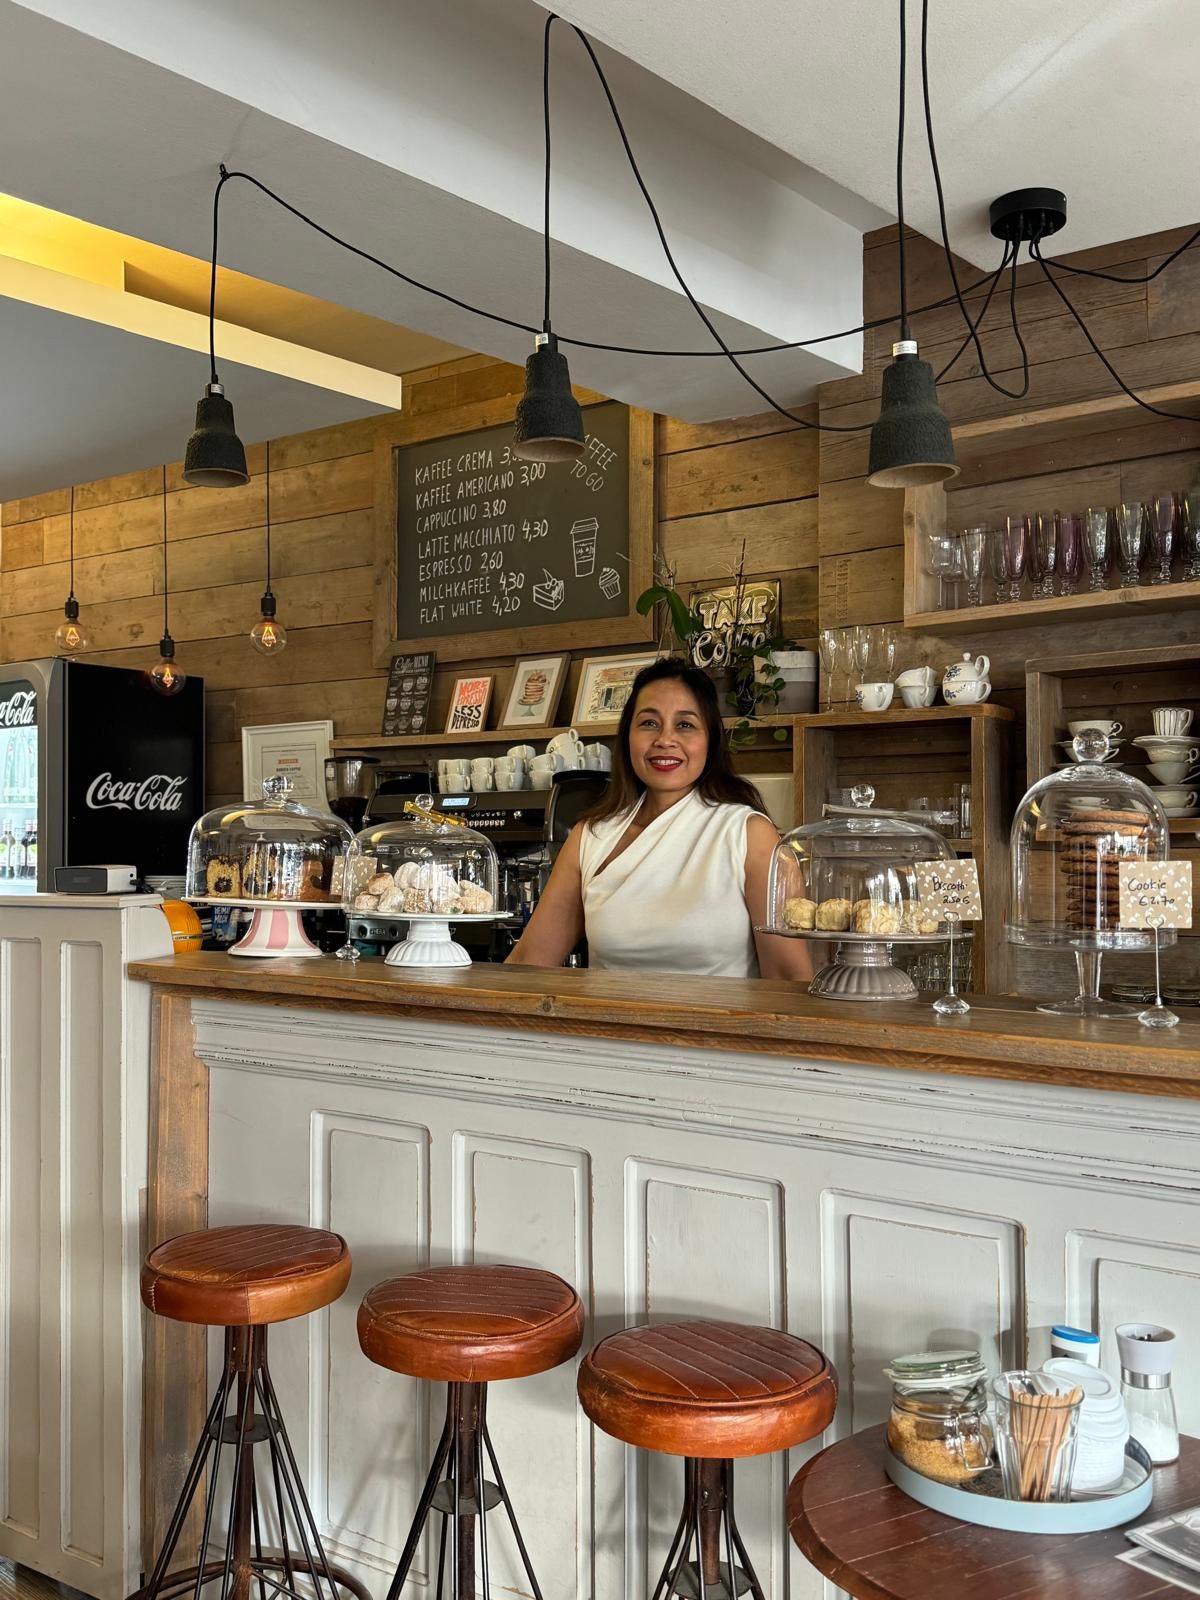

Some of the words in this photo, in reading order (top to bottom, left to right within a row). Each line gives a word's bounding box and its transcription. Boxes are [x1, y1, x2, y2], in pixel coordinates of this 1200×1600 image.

[415, 458, 452, 486] KAFFEE
[457, 450, 493, 472] CREMA
[500, 446, 523, 465] 3,
[570, 459, 588, 478] TO
[585, 472, 604, 491] GO
[416, 483, 451, 511] KAFFEE
[457, 470, 514, 499] AMERICANO
[520, 462, 546, 486] 3,00
[416, 503, 477, 533] CAPPUCCINO
[482, 499, 506, 518] 3,80
[418, 535, 450, 559] LATTE
[454, 523, 515, 552] MACCHIATO
[522, 519, 549, 542] 4,30
[419, 554, 472, 581] ESPRESSO
[481, 550, 503, 572] 2,60
[420, 576, 491, 602] MILCHKAFFEE
[500, 571, 525, 595] 4,30
[420, 605, 445, 624] FLAT
[452, 599, 483, 618] WHITE
[492, 595, 520, 616] 4,20
[699, 595, 768, 630] TAKE
[451, 713, 480, 729] DEPRESSO
[454, 704, 482, 719] LESS
[86, 772, 188, 811] Coca-Cola
[1127, 877, 1167, 892] Cookie
